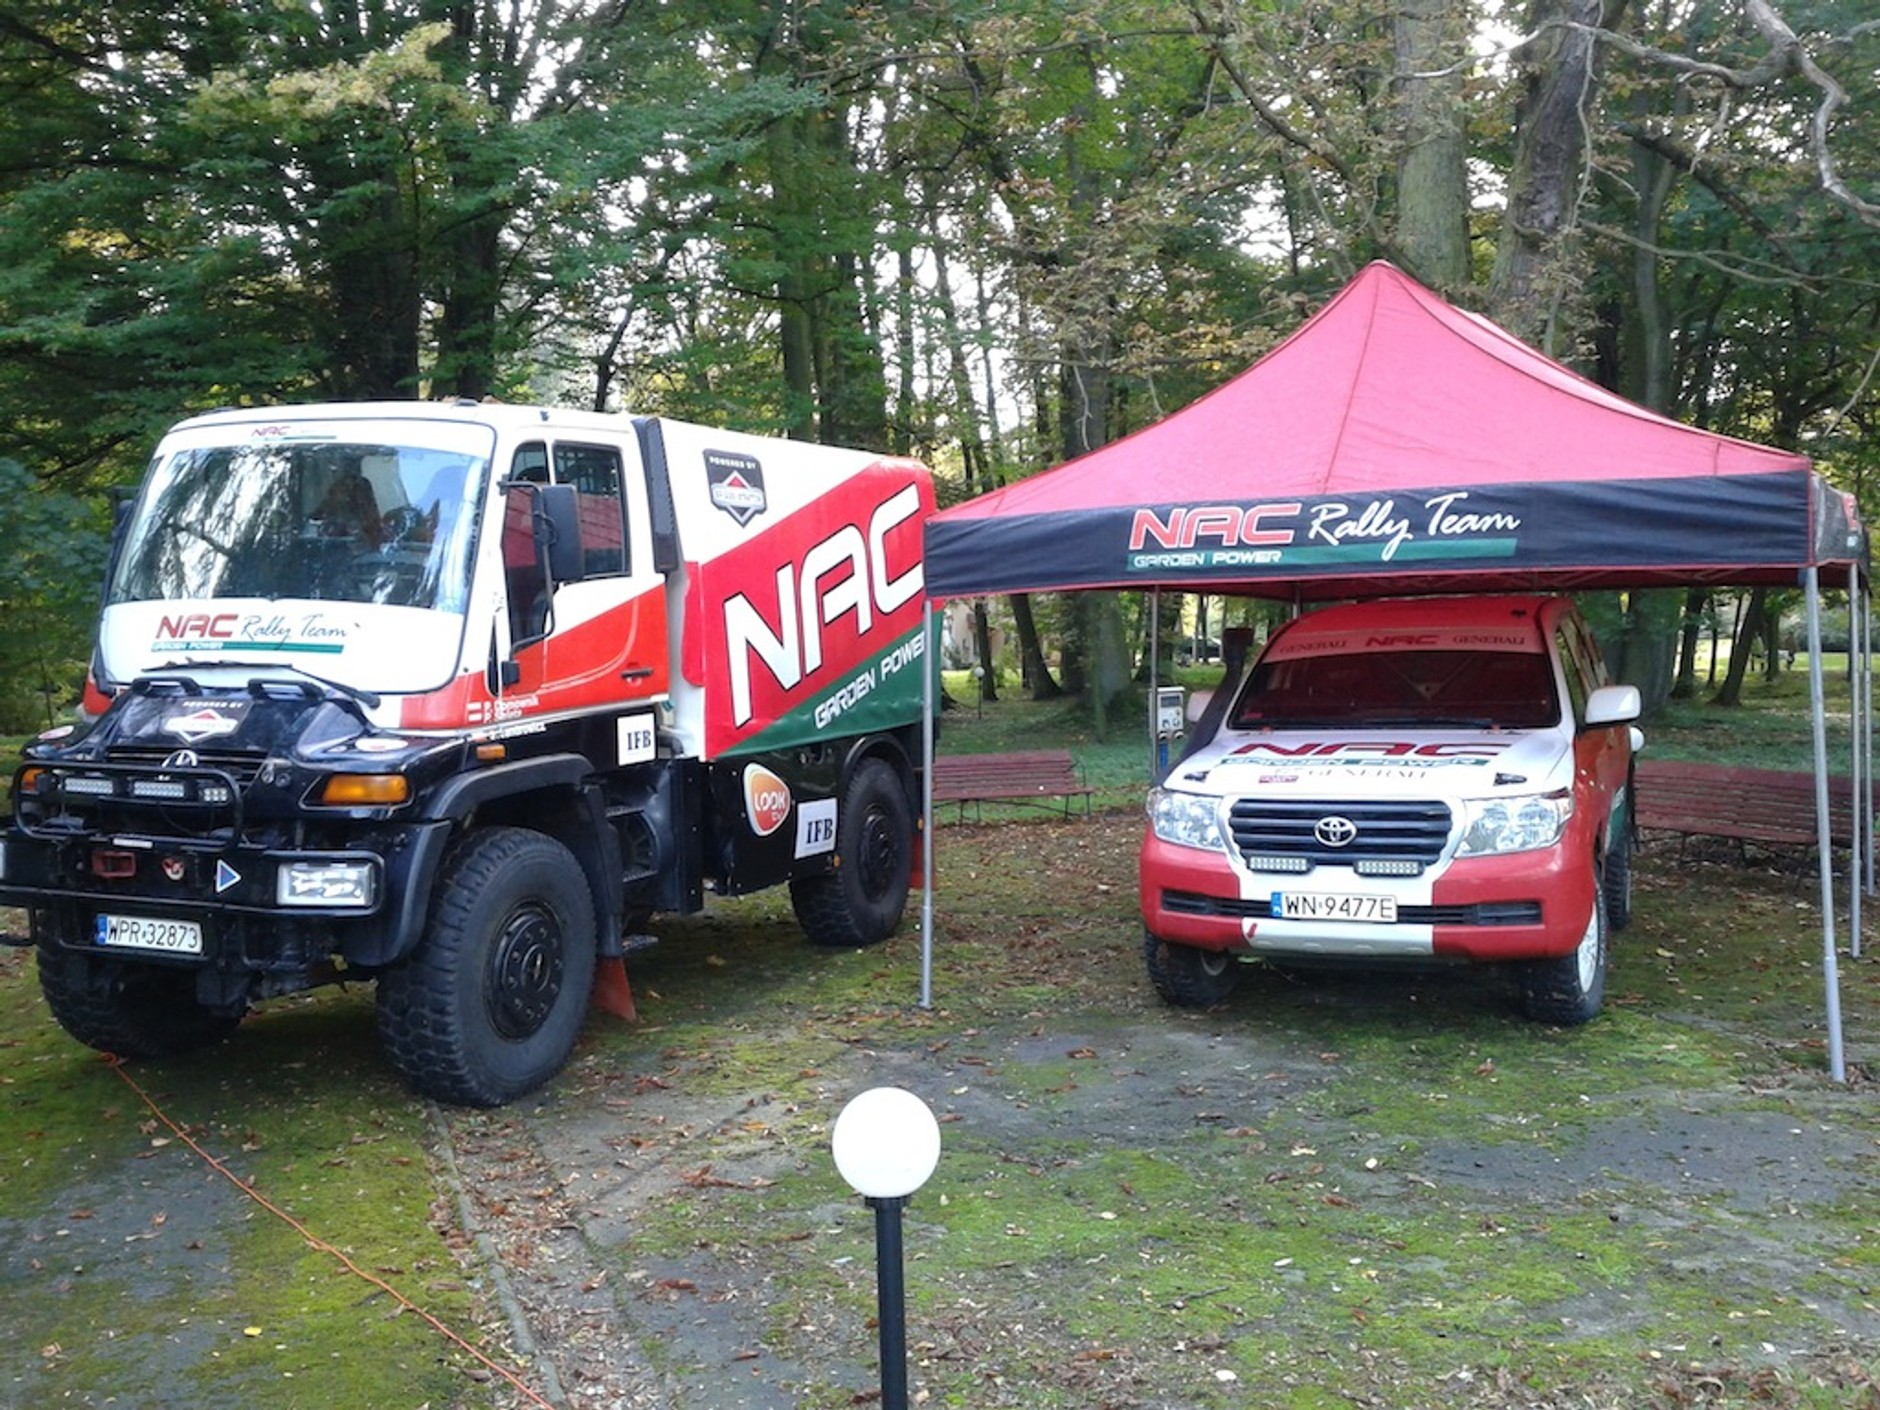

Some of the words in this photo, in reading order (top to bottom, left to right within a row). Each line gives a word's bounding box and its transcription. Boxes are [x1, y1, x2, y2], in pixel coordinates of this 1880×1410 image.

[1129, 504, 1302, 550] NAC
[1308, 500, 1414, 561] Rally
[1425, 492, 1521, 536] Team
[1133, 554, 1204, 568] GARDEN
[1212, 550, 1282, 564] POWER
[723, 481, 925, 730] NAC
[156, 613, 239, 639] NAC
[241, 615, 291, 650] Rally
[300, 614, 349, 638] Team
[1365, 634, 1439, 647] NAC
[1453, 634, 1526, 646] GENERALI
[814, 667, 876, 730] GARDEN
[880, 631, 926, 681] POWE
[627, 729, 652, 751] IFB
[1229, 743, 1511, 756] NAC
[754, 791, 787, 811] LOOK
[806, 818, 834, 844] IFB
[1285, 895, 1317, 916] WN
[1325, 897, 1394, 919] 9477E
[109, 919, 140, 944] WPR
[146, 923, 198, 949] 32873
